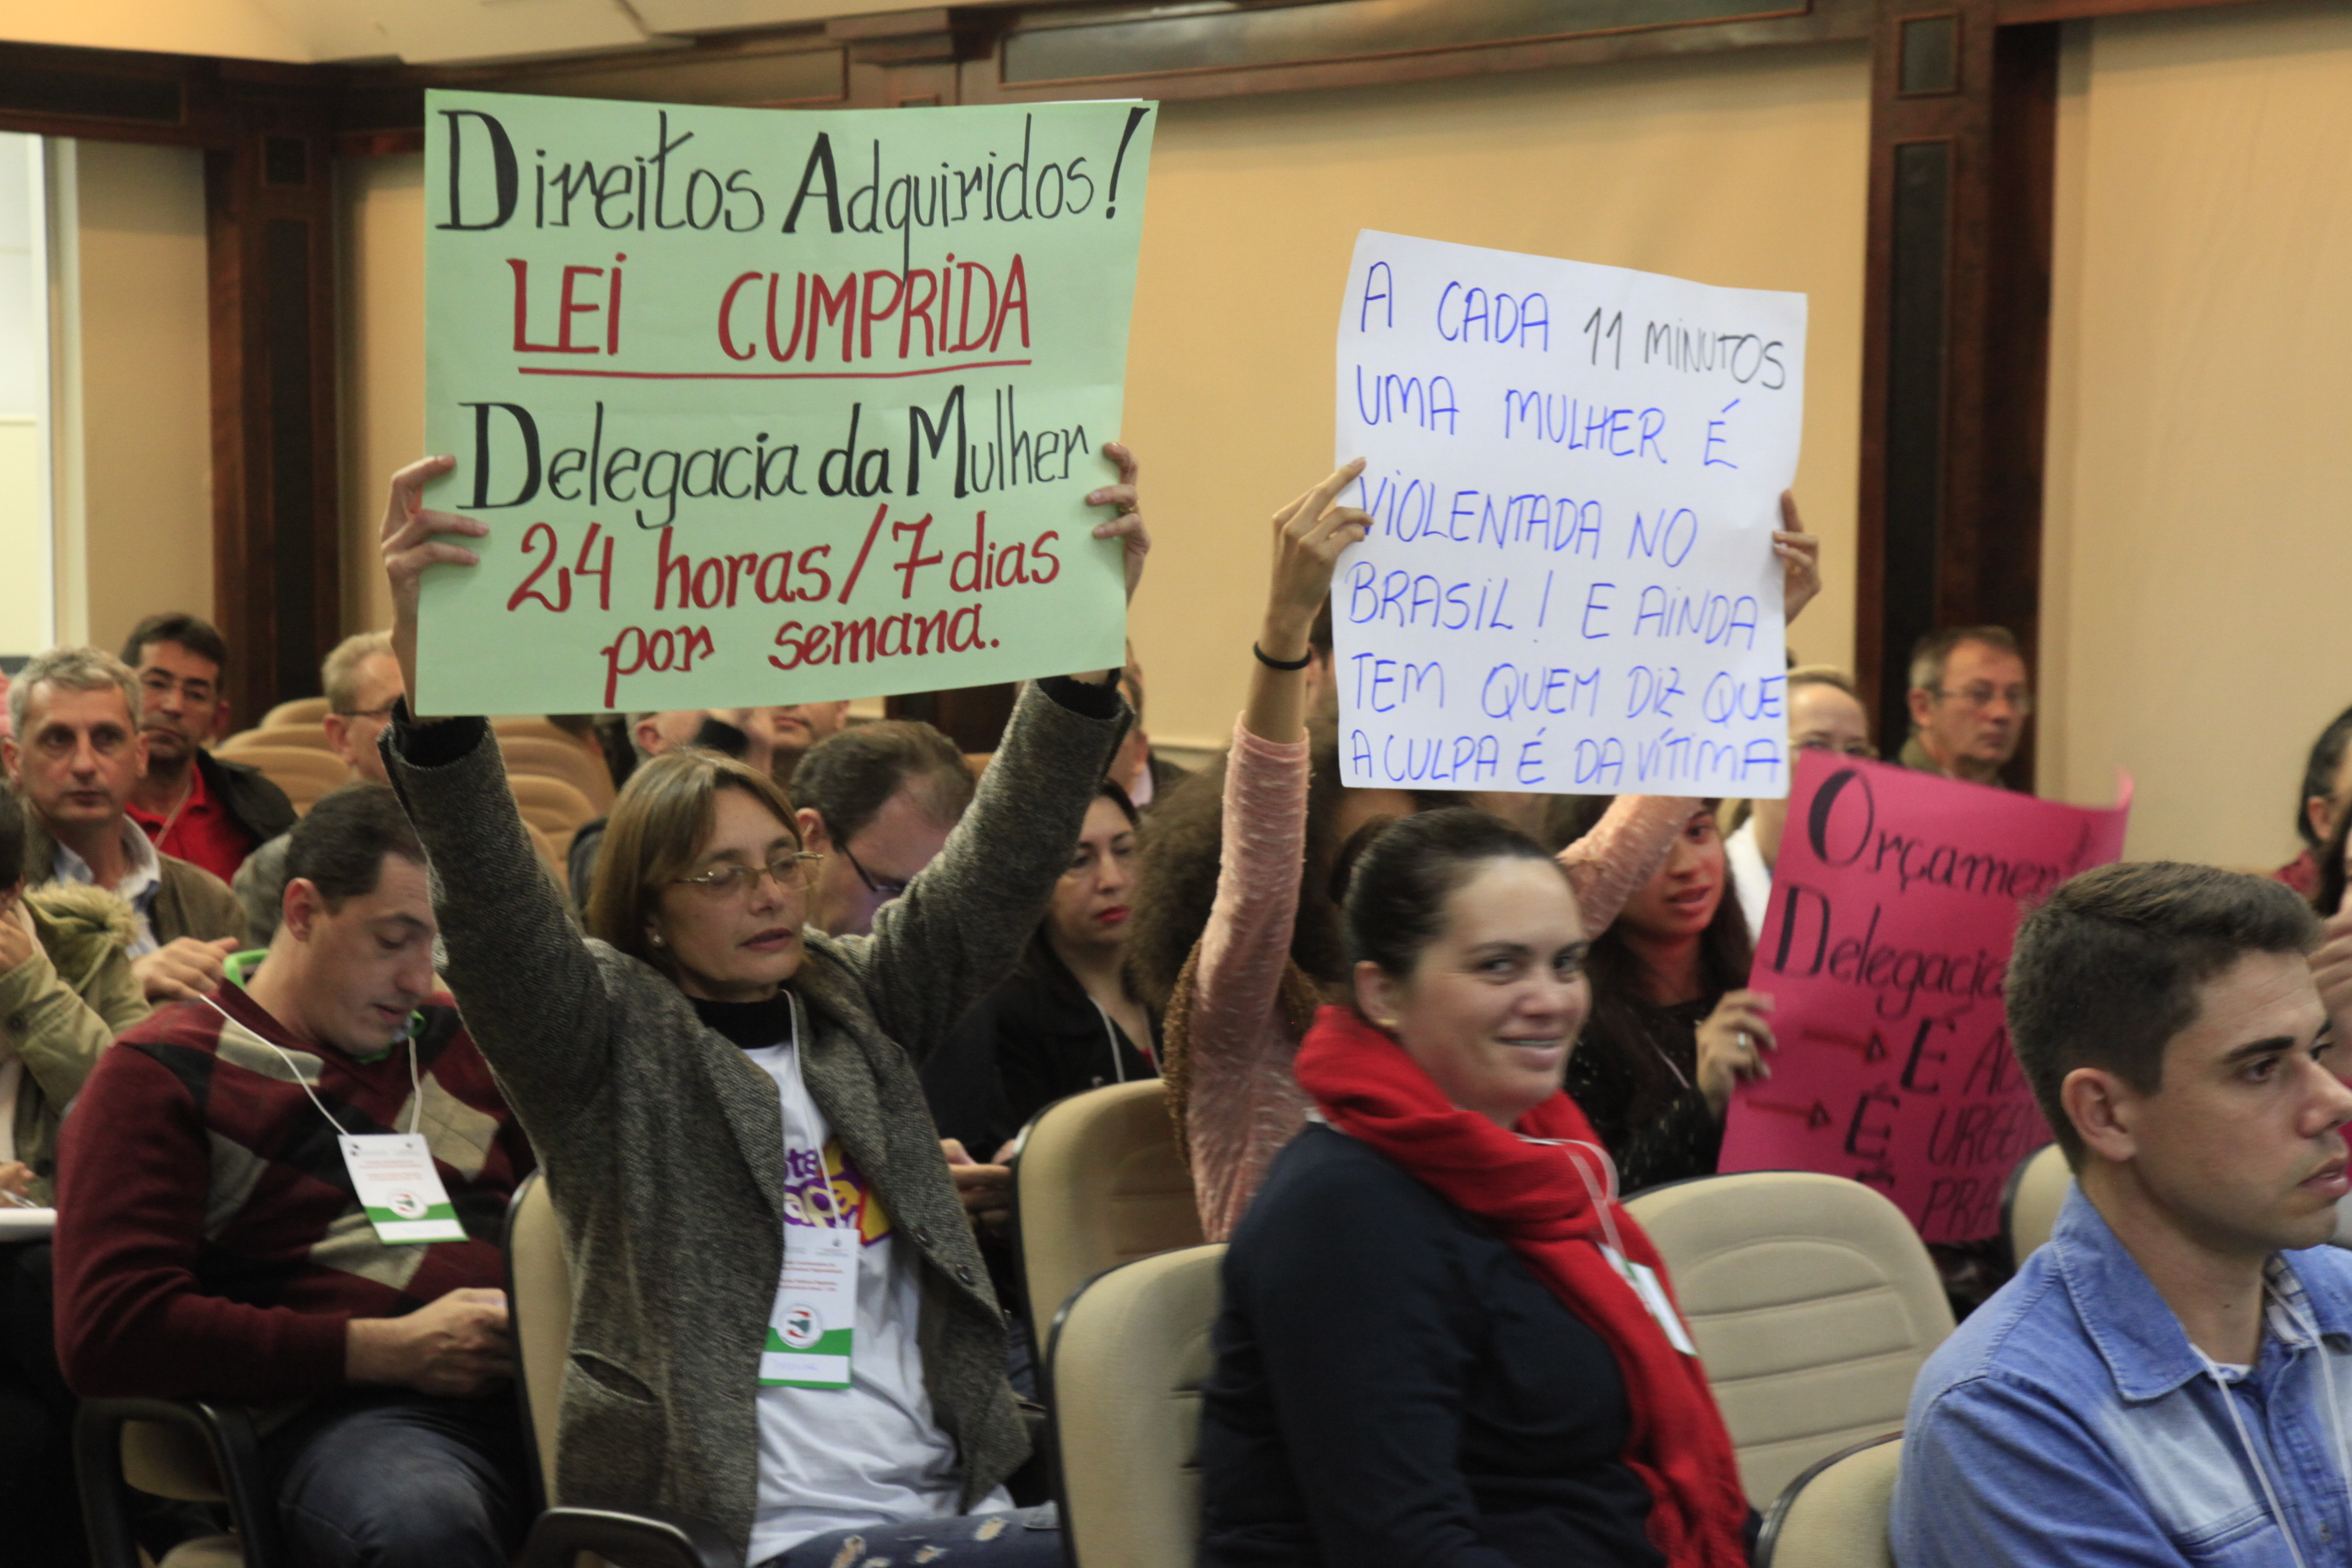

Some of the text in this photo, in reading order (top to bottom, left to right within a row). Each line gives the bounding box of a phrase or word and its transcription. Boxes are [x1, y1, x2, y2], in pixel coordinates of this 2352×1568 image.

[435, 106, 1150, 289] Direitos Adquiridos!
[719, 253, 1031, 362] CUMPRIDA
[1360, 261, 1786, 390] A CADA 11 MINUTOS
[456, 384, 1090, 531] Delegacia da Mulher
[1357, 364, 1741, 470] UMA MULHER É
[507, 522, 614, 611] 24
[1359, 470, 1698, 569] VIOLENTADA NO
[601, 603, 1000, 709] por semana.
[1582, 583, 1617, 640] E
[1634, 585, 1758, 651] AINDA
[1352, 652, 1786, 728] TEM QUEM DIZ QUE
[1517, 727, 1547, 785] É
